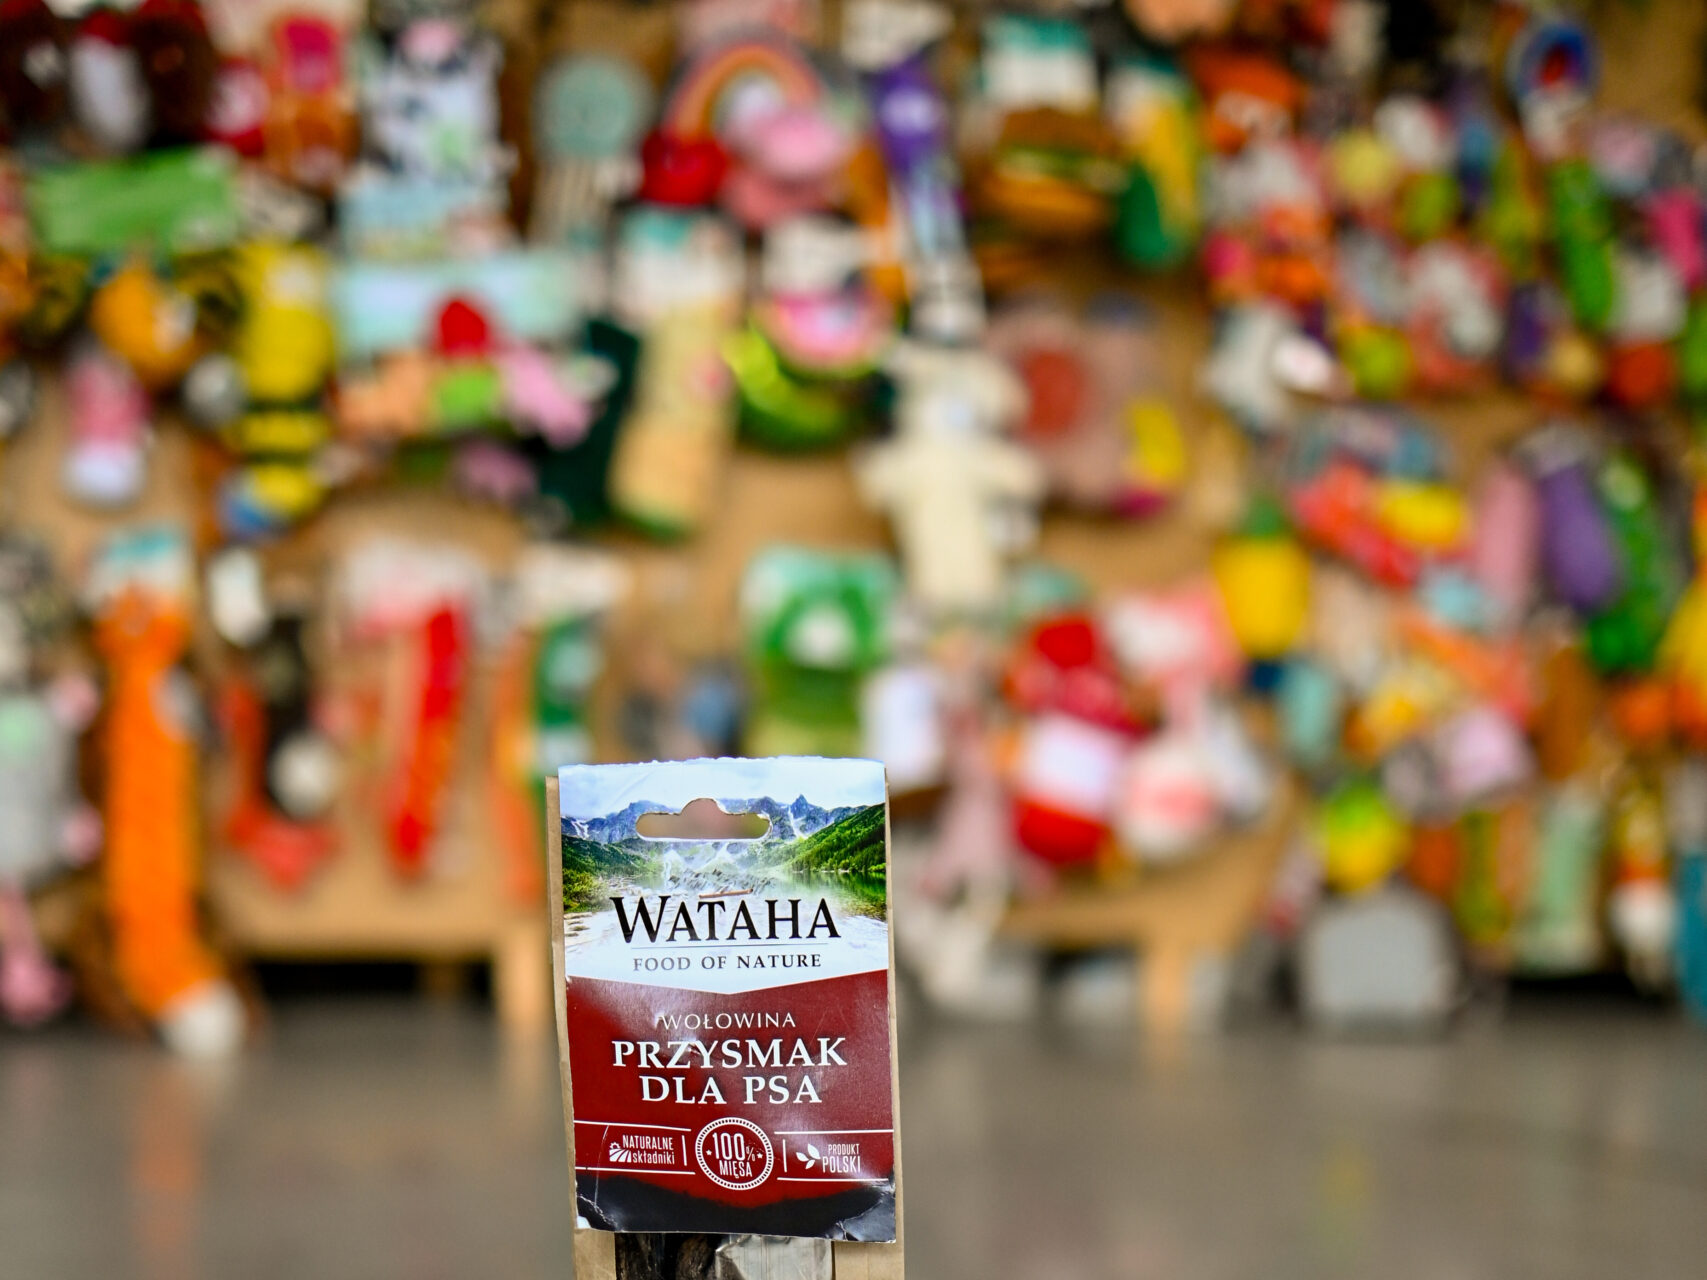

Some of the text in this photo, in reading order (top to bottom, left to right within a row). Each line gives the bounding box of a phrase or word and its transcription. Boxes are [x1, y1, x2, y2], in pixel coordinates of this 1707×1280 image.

[609, 895, 841, 943] WATAHA
[633, 953, 821, 971] FOOD OF NATURE
[658, 1011, 796, 1030] WOŁOWINA
[612, 1037, 847, 1069] PRZYSMAK
[639, 1074, 822, 1104] DLA PSA
[622, 1134, 674, 1151] NATURALNE
[712, 1132, 756, 1162] 100%
[827, 1143, 860, 1155] PRODUKT
[631, 1150, 675, 1165] składniki
[822, 1152, 861, 1173] POLSKI
[719, 1160, 753, 1179] MIĘSA
